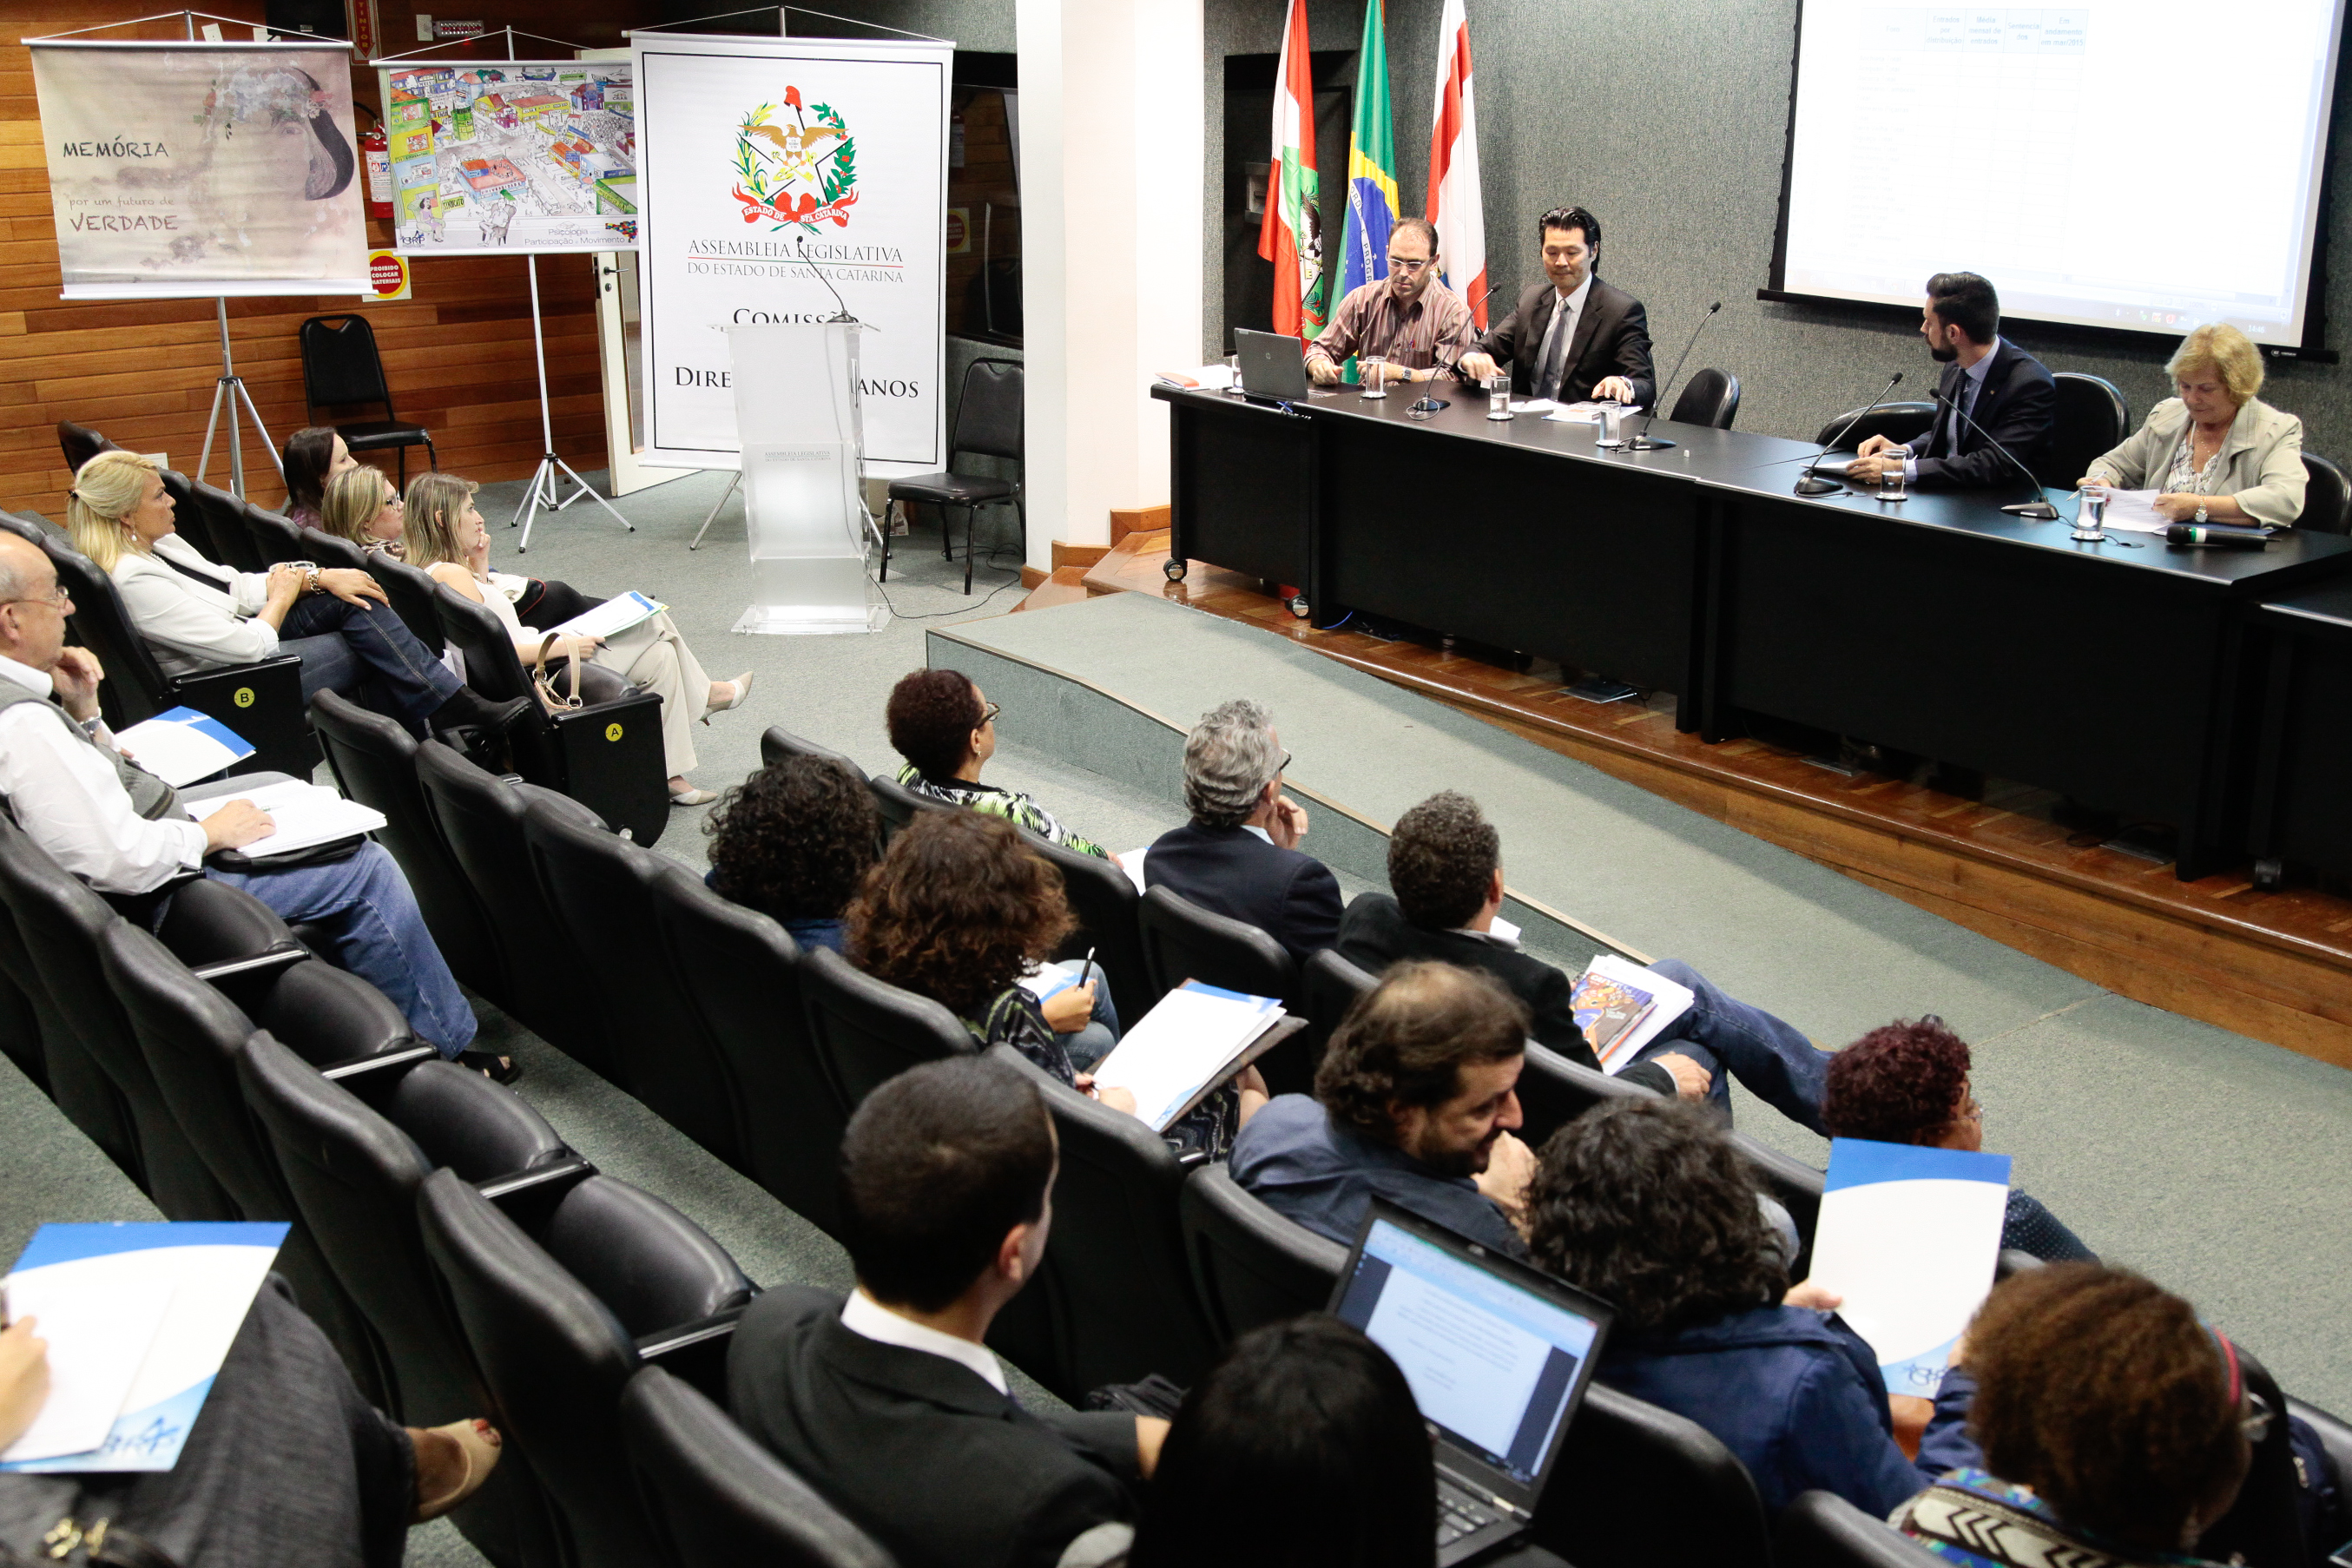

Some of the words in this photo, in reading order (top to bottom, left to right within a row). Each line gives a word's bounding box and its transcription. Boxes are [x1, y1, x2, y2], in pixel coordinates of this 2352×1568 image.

[63, 135, 168, 158] MEMÓRIA
[69, 198, 89, 210] por
[117, 195, 155, 208] futuro
[160, 196, 175, 206] de
[69, 212, 178, 233] VERDADE
[743, 206, 773, 216] ESTADO
[774, 211, 785, 221] DE
[688, 240, 792, 258] ASSEMBLEIA
[798, 243, 904, 262] LEGISLATIVA
[1363, 242, 1373, 282] PROGR
[688, 262, 709, 274] DO
[714, 263, 765, 277] ESTADO
[769, 266, 787, 278] DE
[791, 267, 833, 280] SANTA
[836, 268, 904, 283] CATARINA
[2248, 325, 2265, 333] 14:46
[240, 693, 249, 702] B
[611, 728, 619, 737] A
